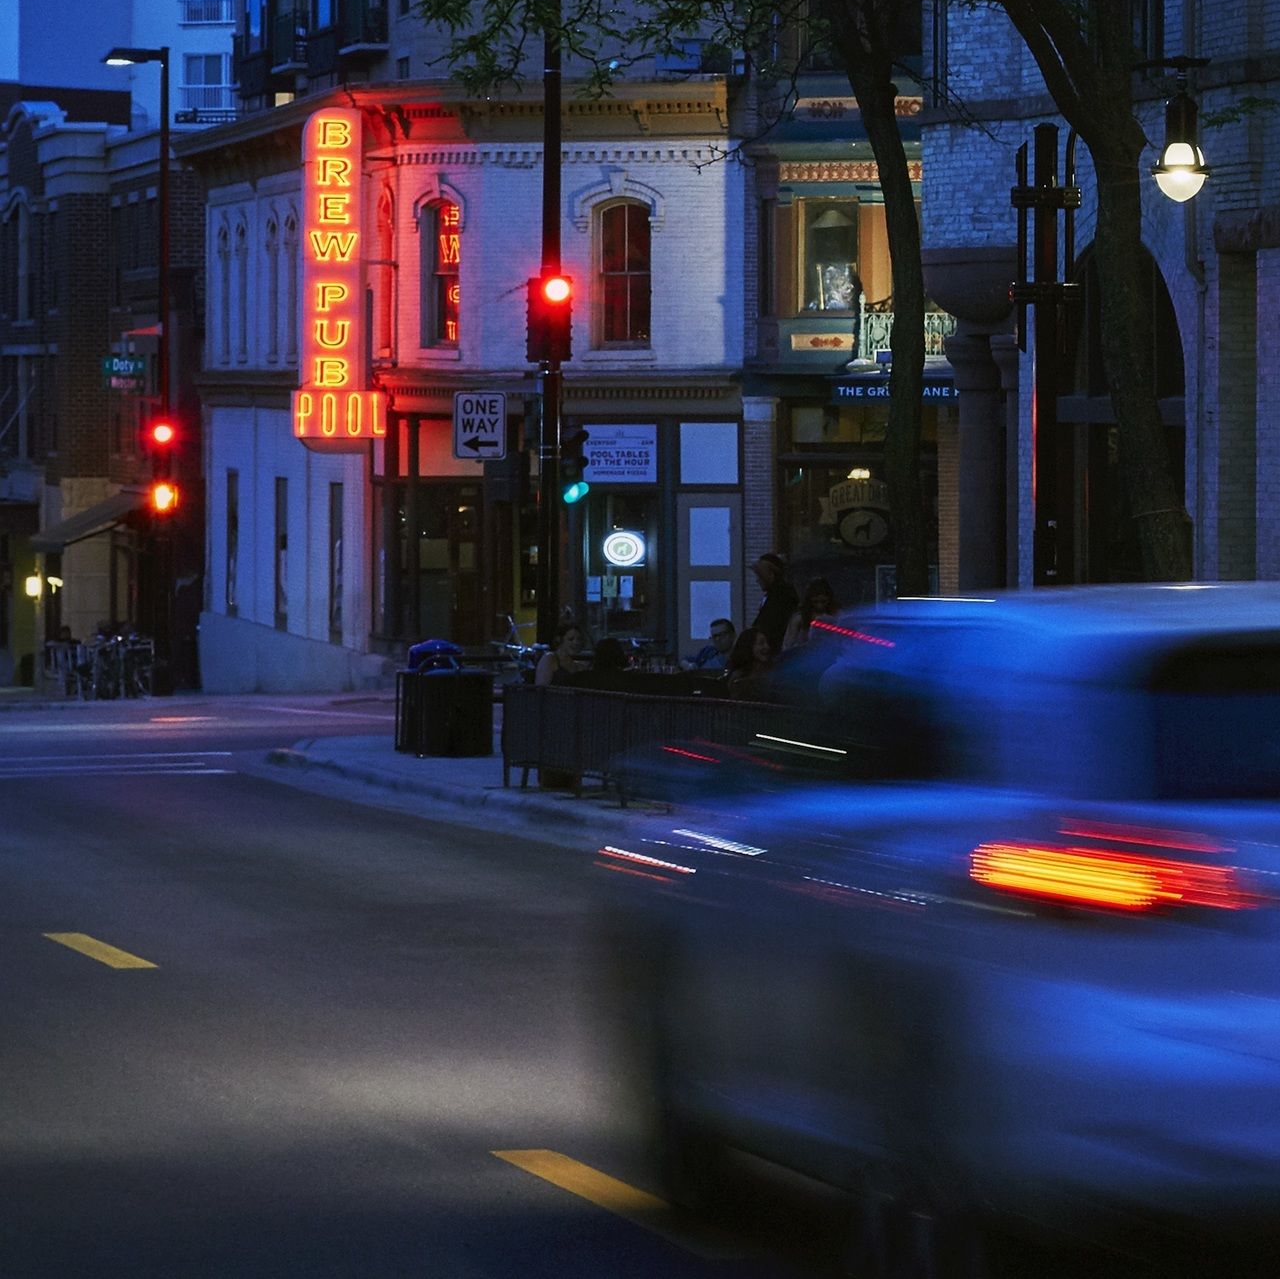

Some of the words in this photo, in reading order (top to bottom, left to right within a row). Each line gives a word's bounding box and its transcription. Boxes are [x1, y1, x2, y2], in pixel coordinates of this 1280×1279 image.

[309, 118, 358, 262] BREW
[315, 283, 349, 388] PUB
[113, 358, 135, 374] Doty
[838, 386, 864, 396] THE
[922, 386, 951, 396] ANE
[296, 392, 386, 437] POOL
[463, 399, 499, 415] ONE
[462, 418, 499, 433] WAY
